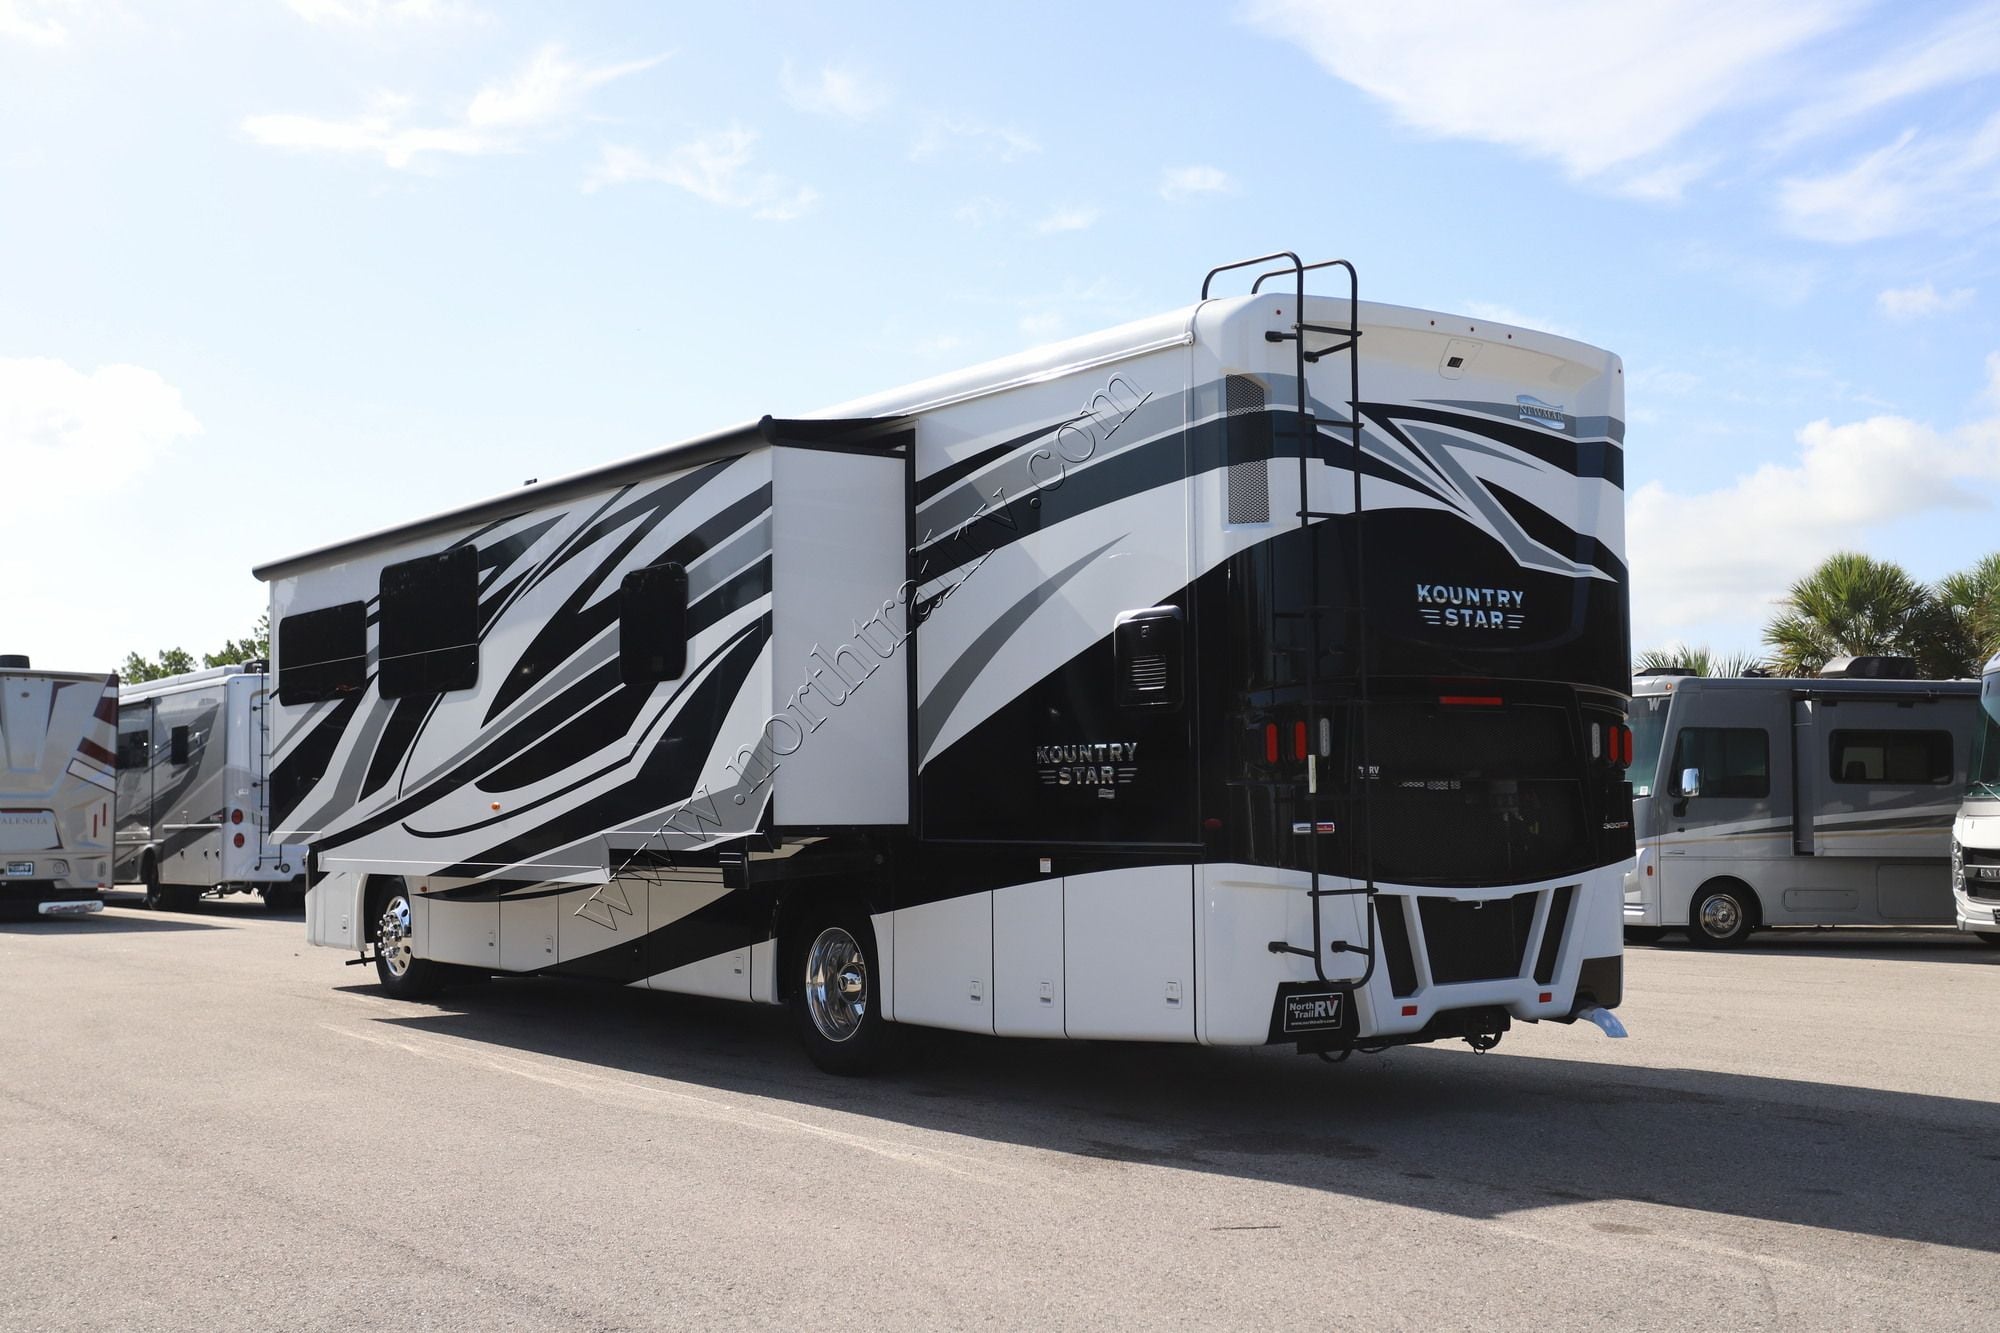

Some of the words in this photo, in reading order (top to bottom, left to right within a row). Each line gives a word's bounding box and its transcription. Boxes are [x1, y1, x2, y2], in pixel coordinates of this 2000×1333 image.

[1519, 405, 1564, 421] NEWMAR
[1416, 583, 1524, 608] KOUNTRY
[1445, 608, 1504, 629] STAR
[1036, 742, 1138, 764] KOUNTRY
[1059, 765, 1114, 785] STAR
[1289, 1002, 1314, 1011] North
[1294, 1010, 1314, 1019] Trail
[1314, 999, 1339, 1018] RV
